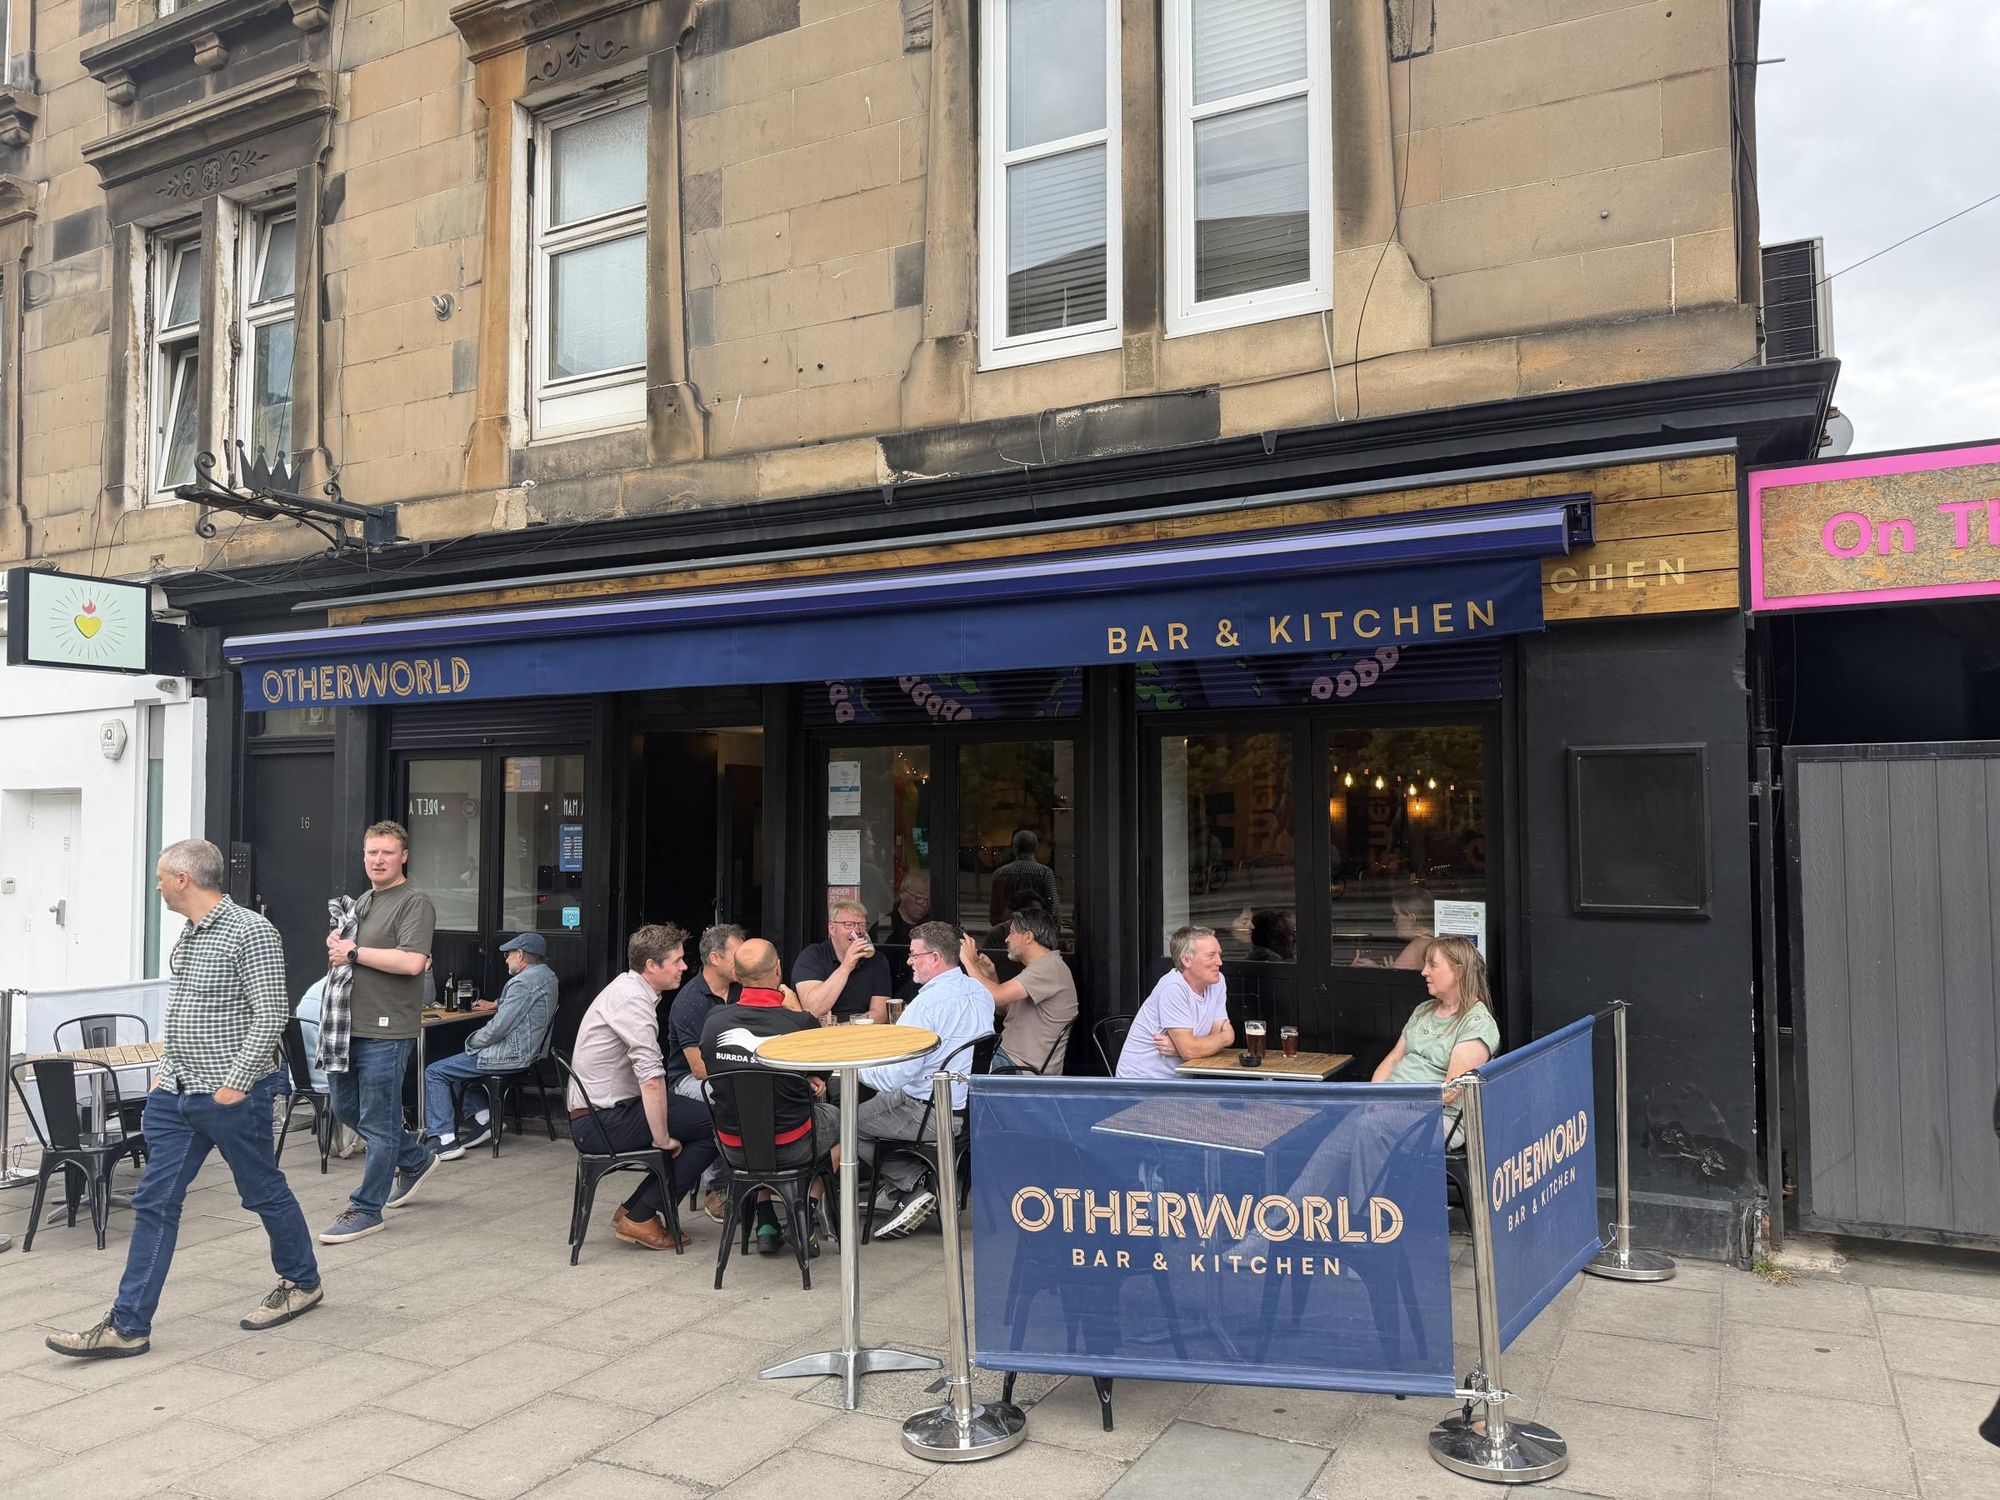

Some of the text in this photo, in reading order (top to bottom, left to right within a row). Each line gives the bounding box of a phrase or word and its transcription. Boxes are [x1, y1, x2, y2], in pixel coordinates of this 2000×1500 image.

[1820, 510, 1918, 560] On
[1106, 599, 1496, 656] BAR & KITCHEN
[262, 656, 471, 704] OTHERWORLD
[301, 816, 310, 830] 16
[716, 1052, 749, 1063] BURRDA
[1492, 1110, 1587, 1212] OTHERWORLD
[1011, 1185, 1404, 1245] OTHERWORLD
[1508, 1166, 1576, 1232] BAR & KITCHEN
[1071, 1248, 1341, 1277] BAR & KITCHEN
